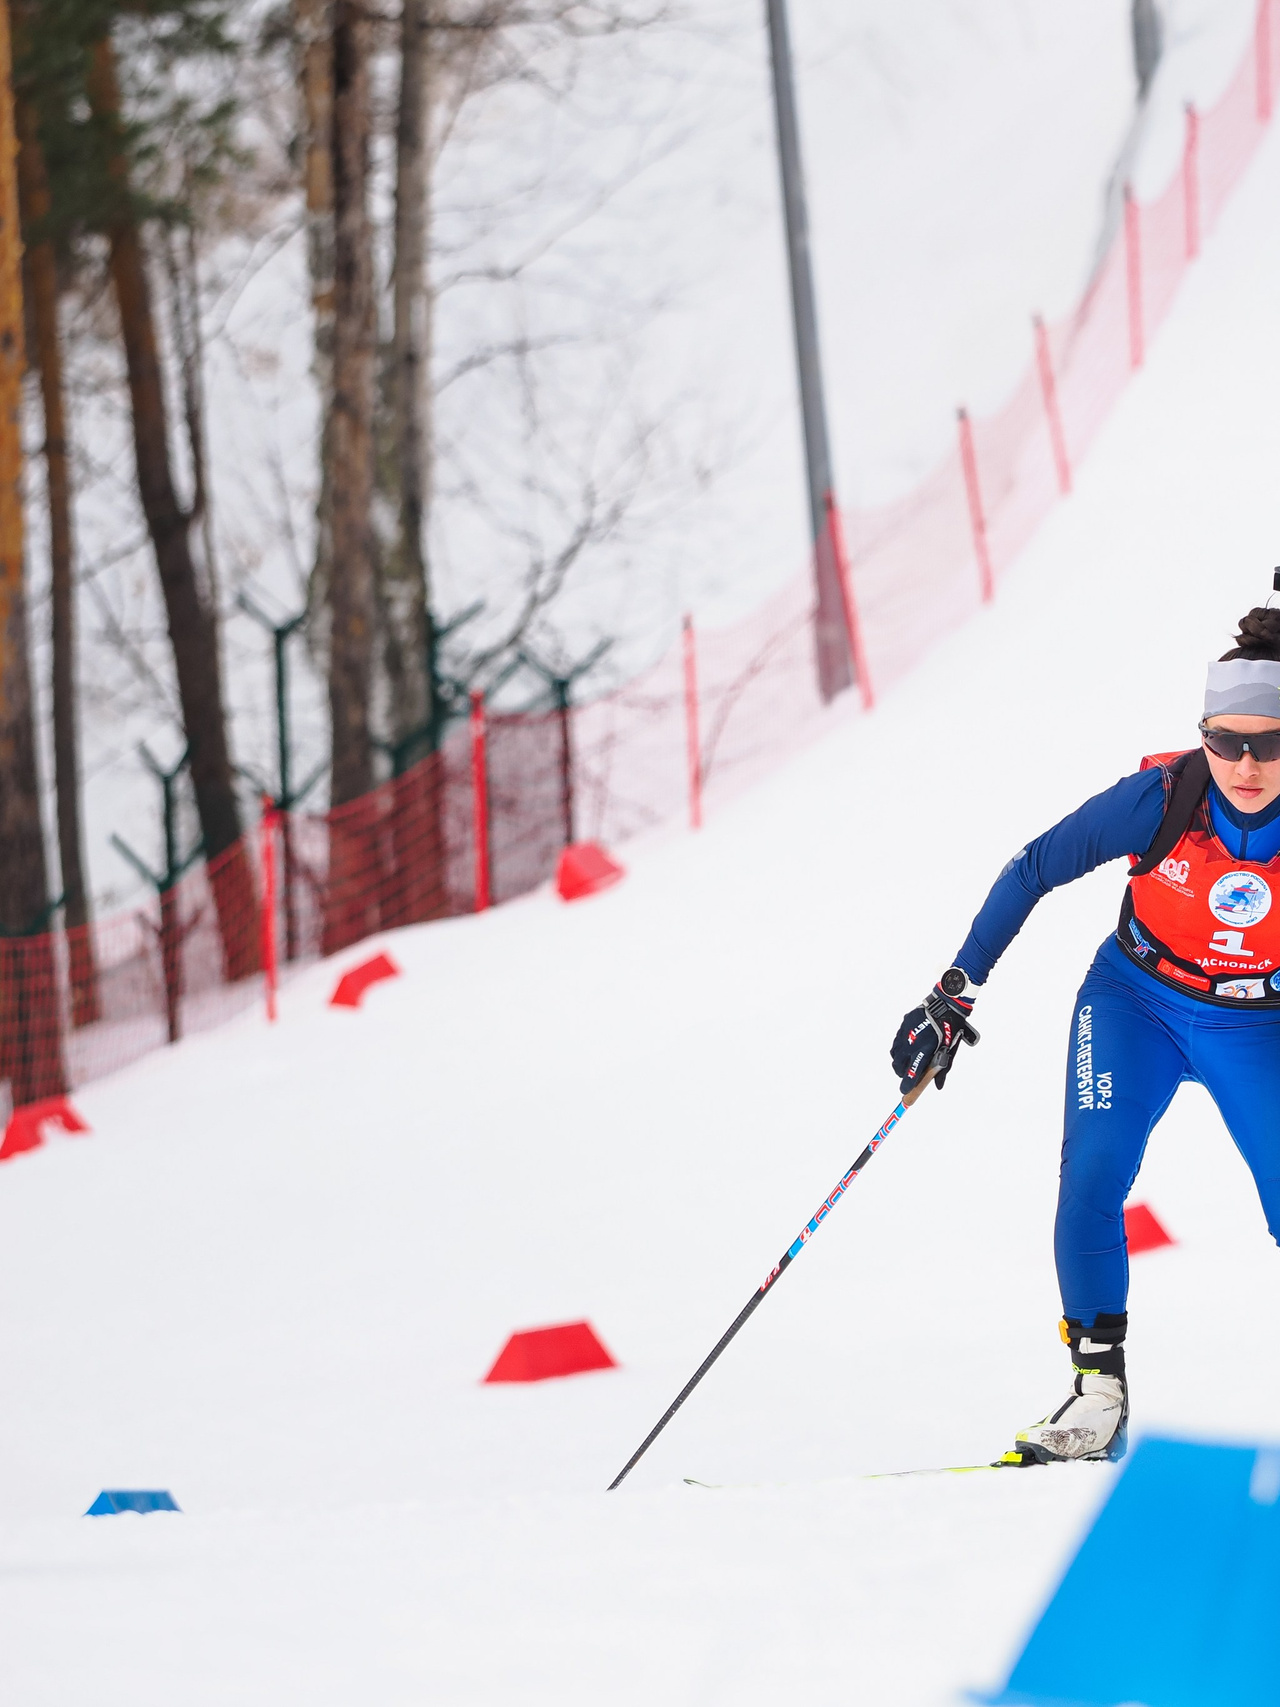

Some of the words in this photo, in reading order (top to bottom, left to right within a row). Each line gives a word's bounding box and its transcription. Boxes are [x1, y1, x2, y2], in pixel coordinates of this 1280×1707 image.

[1208, 930, 1254, 957] 1
[1076, 1004, 1095, 1110] САНКТ-ПЕТЕРБУРГ
[1096, 1071, 1113, 1110] УОР-2
